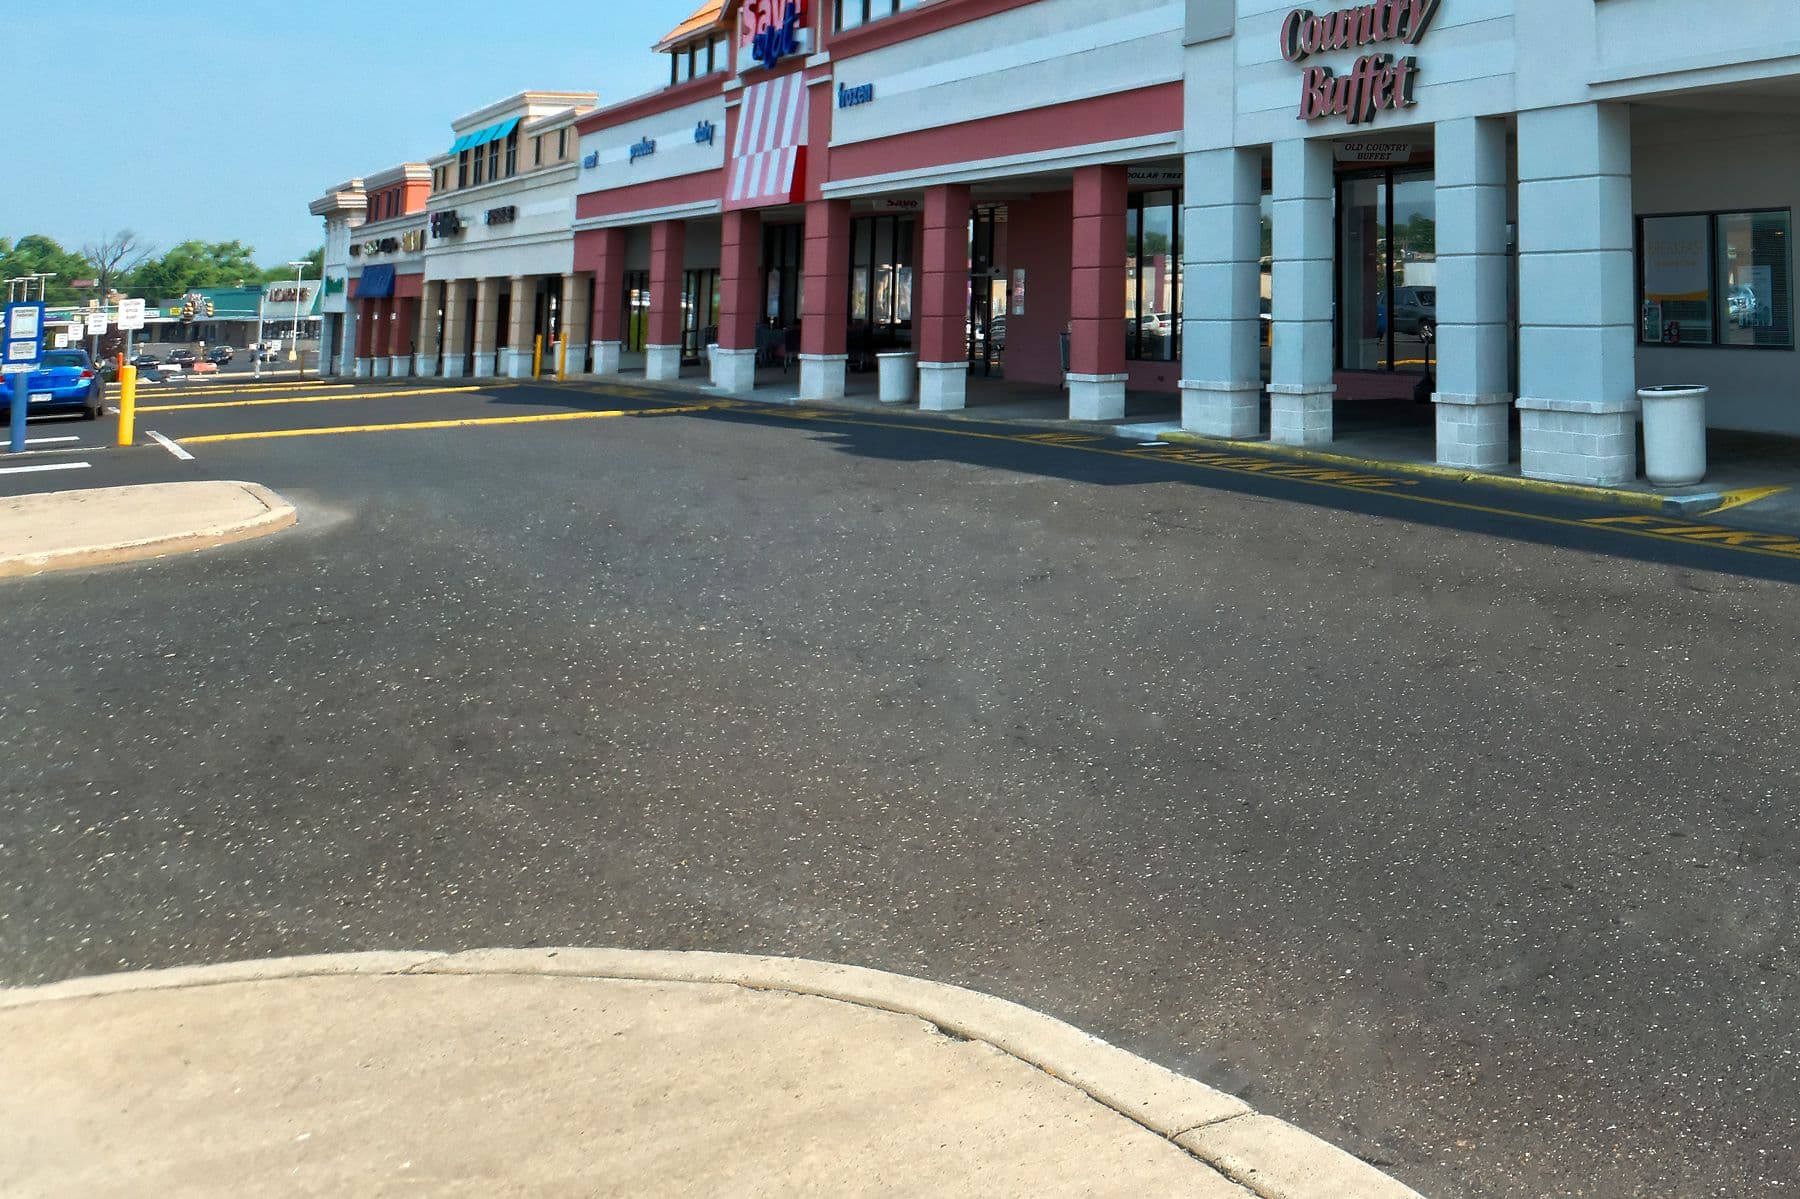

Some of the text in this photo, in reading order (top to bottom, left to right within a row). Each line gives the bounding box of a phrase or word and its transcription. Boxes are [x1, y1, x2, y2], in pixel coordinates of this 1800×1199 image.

[1297, 53, 1420, 124] Buffet
[1345, 143, 1409, 152] OLD COUNTRY
[1357, 152, 1392, 161] BUFFET
